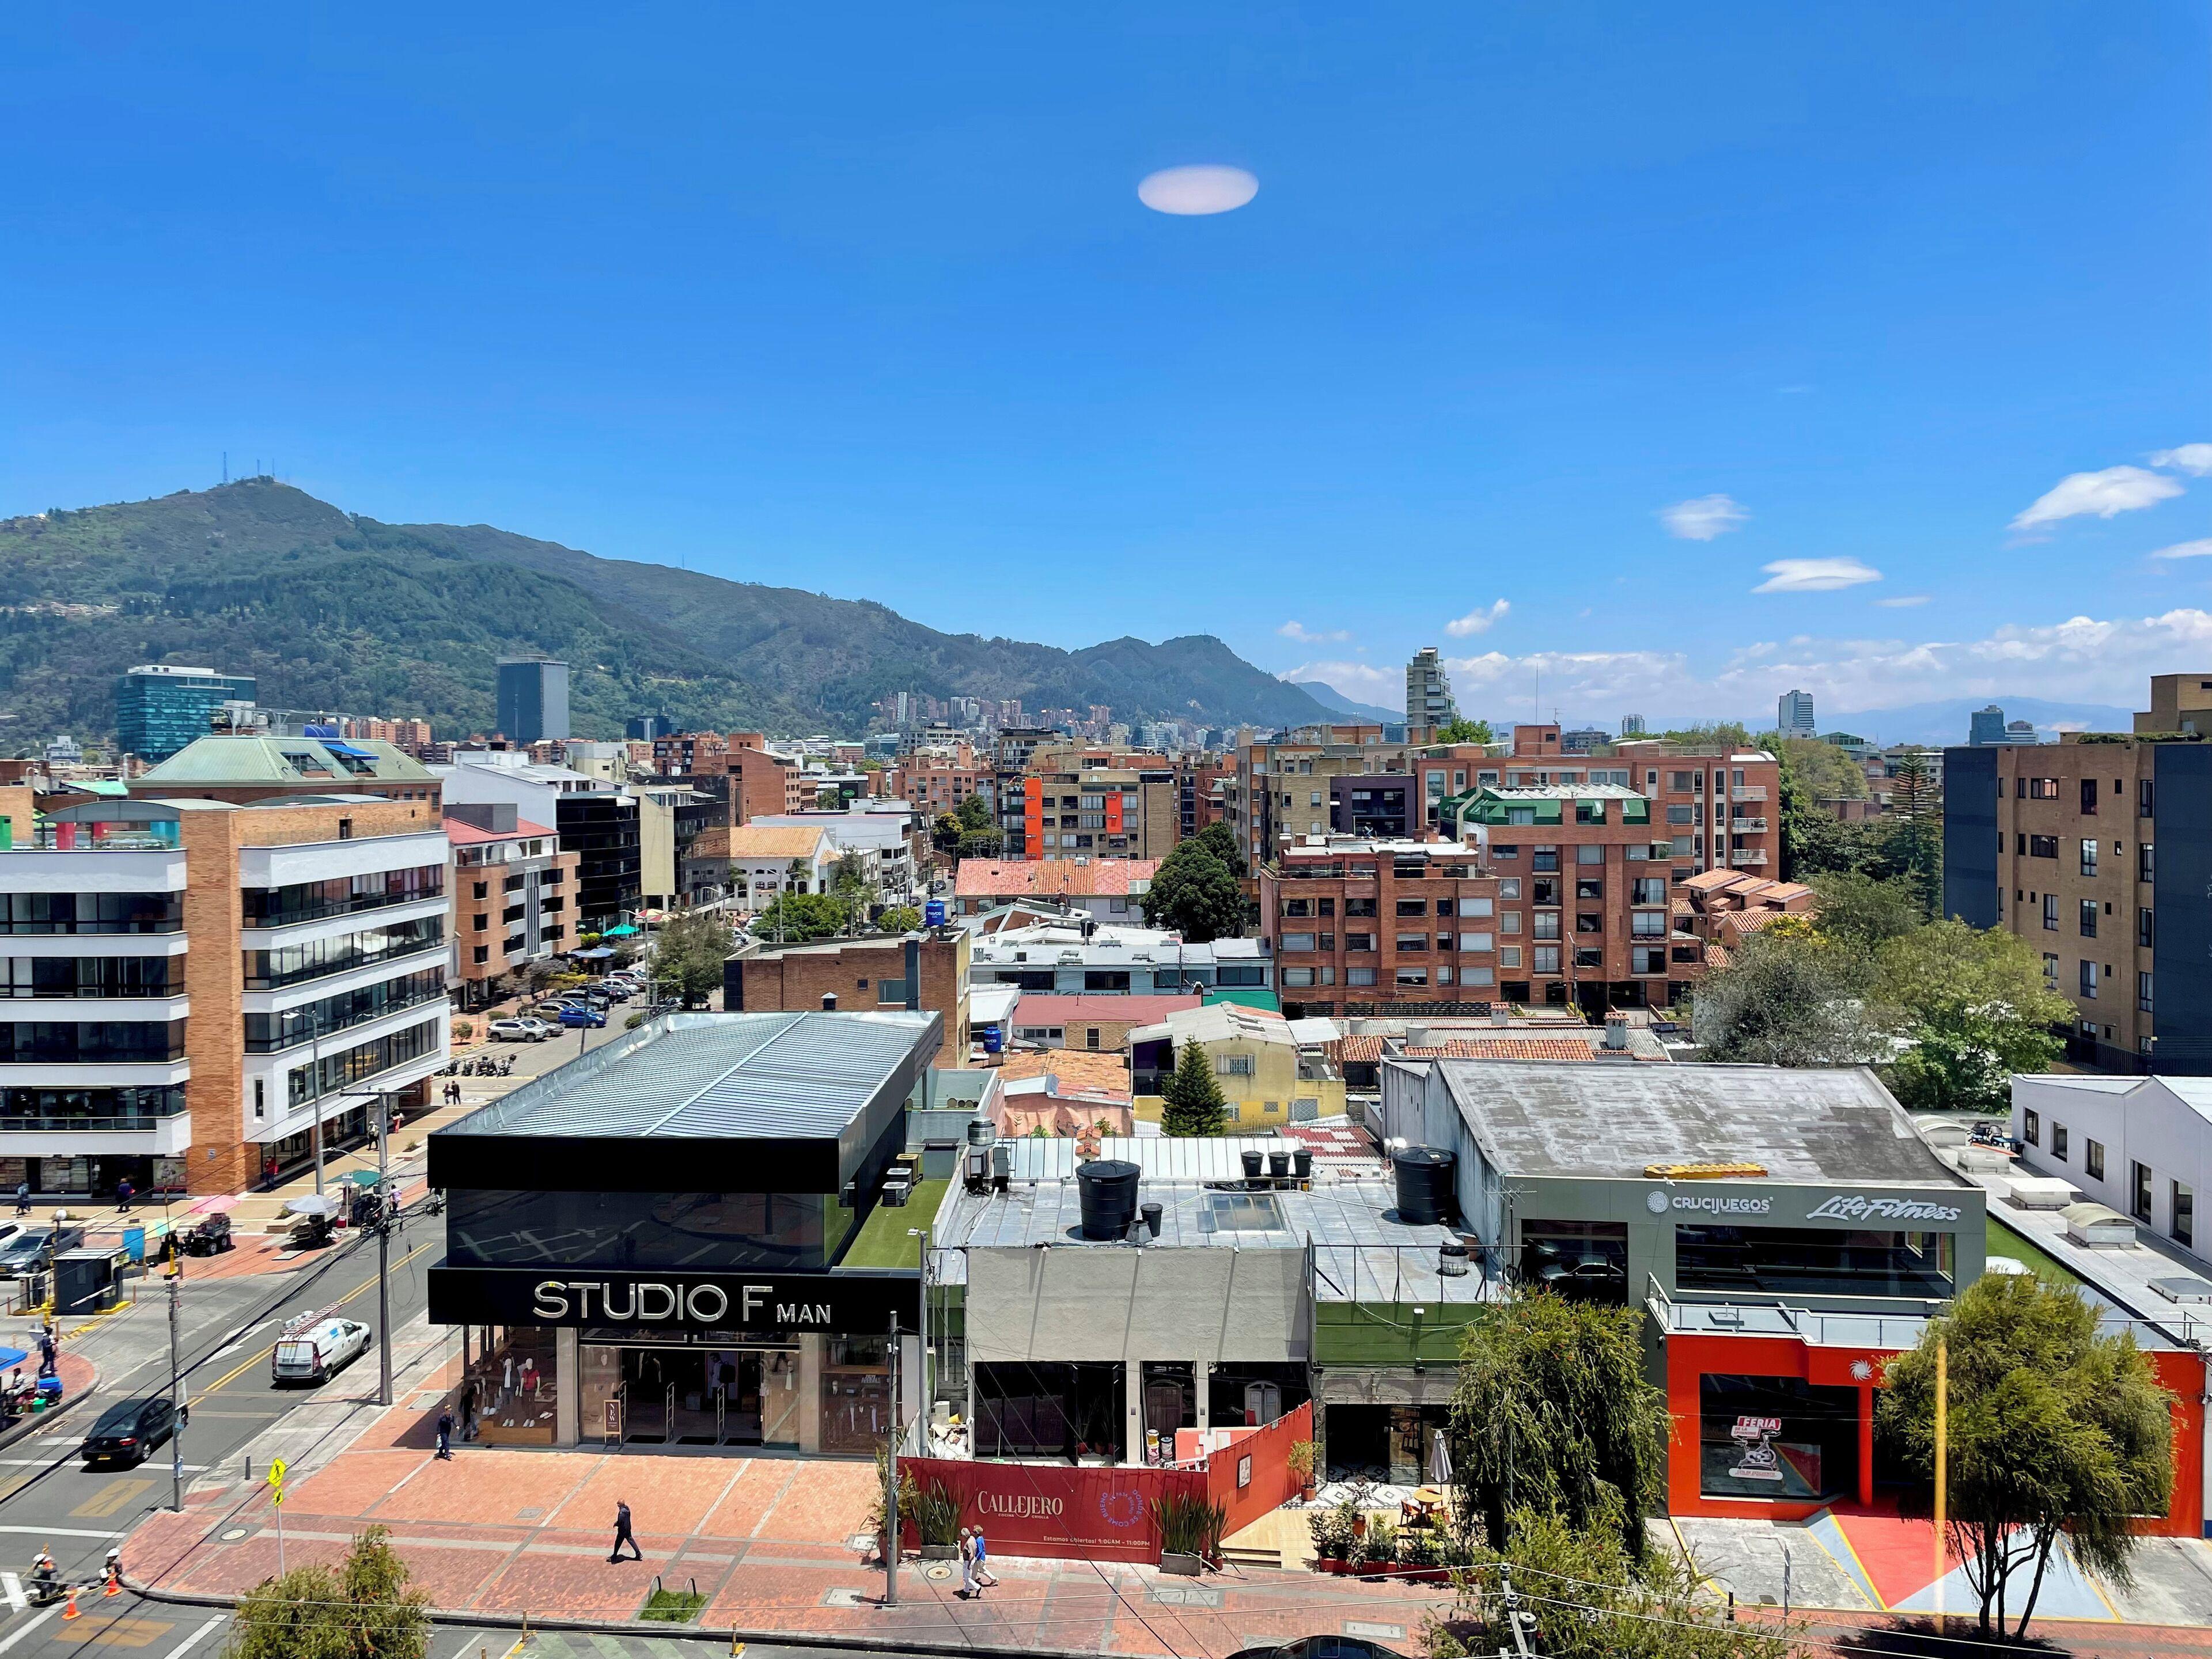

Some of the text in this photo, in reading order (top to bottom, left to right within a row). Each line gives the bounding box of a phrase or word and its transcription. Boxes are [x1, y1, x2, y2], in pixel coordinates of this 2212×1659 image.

[1672, 1196, 1770, 1214] CRUCIJUEGOS
[533, 1281, 831, 1323] STUDIO F MAN
[1743, 1418, 1776, 1429] FERIA
[978, 1491, 1063, 1518] CALLEJERO
[1100, 1493, 1109, 1517] BUENO
[1132, 1490, 1143, 1515] DONDE
[1107, 1517, 1129, 1527] COME
